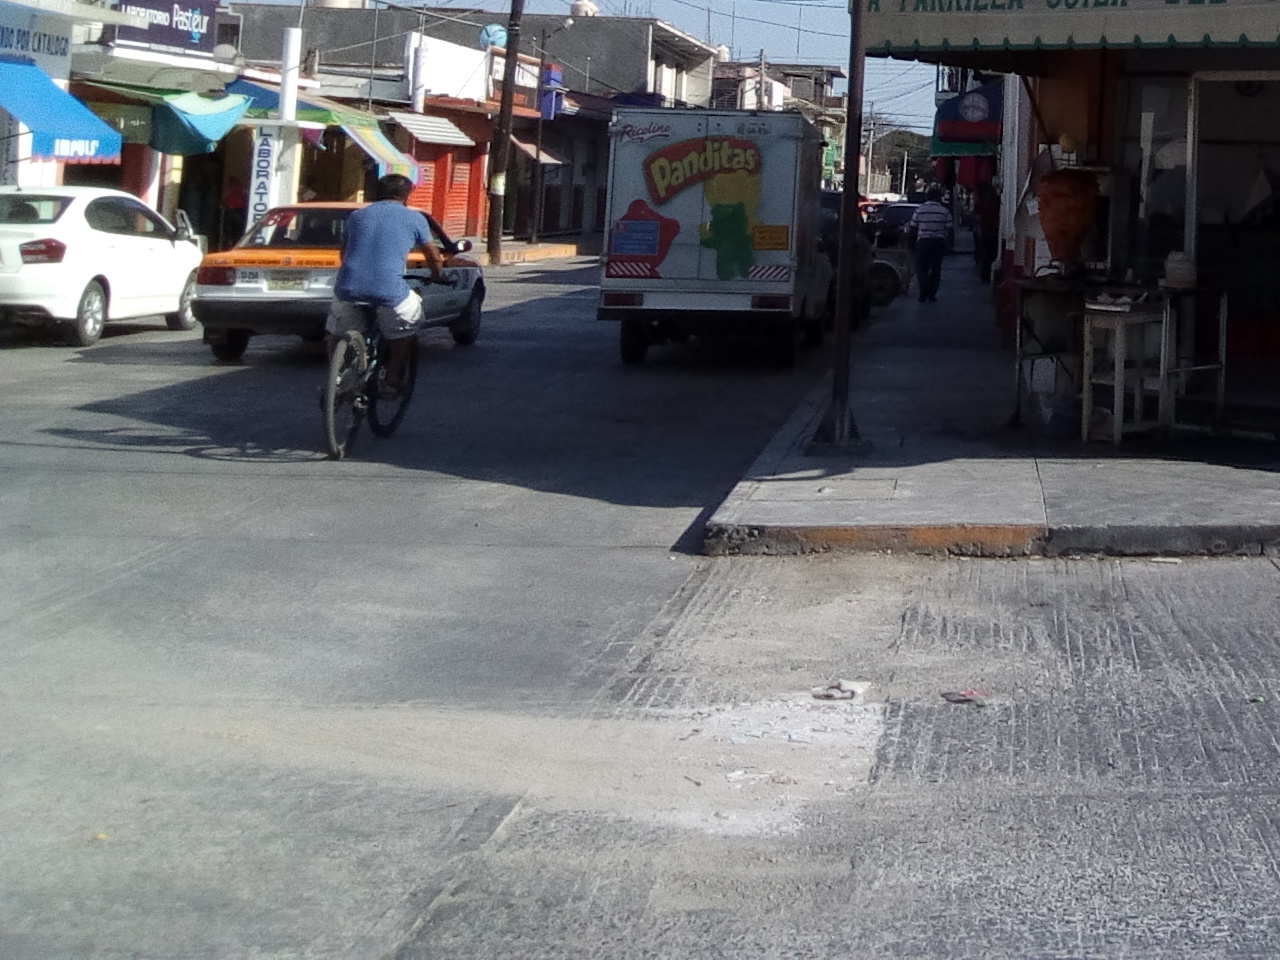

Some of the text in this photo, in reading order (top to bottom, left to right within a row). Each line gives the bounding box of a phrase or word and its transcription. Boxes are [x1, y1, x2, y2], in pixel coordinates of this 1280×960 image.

[172, 3, 209, 33] Pasteur
[620, 122, 670, 143] Ricolino
[651, 141, 756, 198] Panditas
